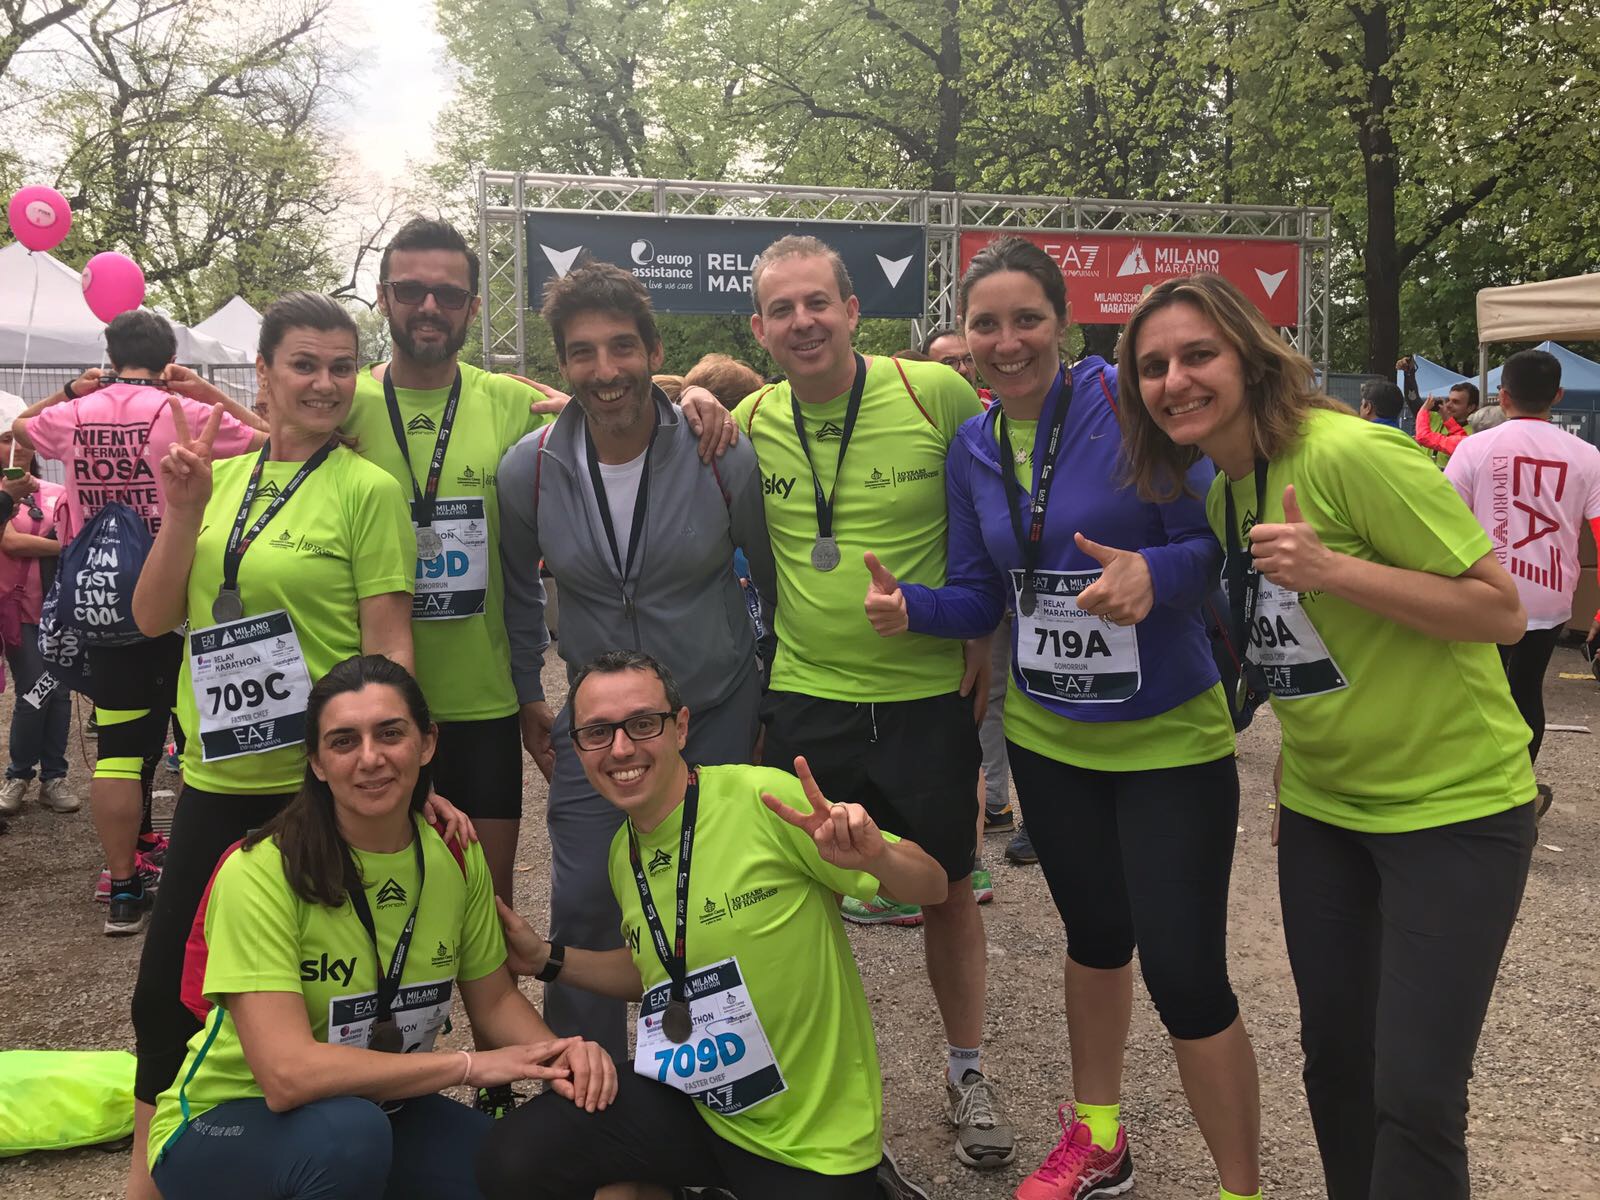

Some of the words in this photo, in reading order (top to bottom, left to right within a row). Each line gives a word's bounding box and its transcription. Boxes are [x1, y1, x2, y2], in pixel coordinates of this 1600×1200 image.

[657, 254, 692, 267] europ
[708, 253, 760, 271] RELA
[1155, 248, 1219, 264] MILANO
[632, 265, 693, 278] assistance
[1155, 263, 1219, 274] MARATHON
[648, 280, 662, 289] live
[677, 281, 693, 290] care
[708, 275, 753, 292] MAR
[1094, 293, 1122, 302] MILANO
[73, 428, 150, 446] NIENTE
[84, 447, 130, 458] FERMA
[74, 458, 154, 480] ROSA
[765, 473, 796, 499] sky
[1493, 456, 1508, 521] EMPORIO
[79, 488, 159, 505] NIENTE
[1511, 456, 1568, 592] EA7
[87, 547, 118, 570] RUN
[416, 551, 470, 578] 19D
[76, 569, 120, 589] FAST
[1069, 578, 1098, 587] MILAN
[74, 588, 120, 605] LIVE
[1044, 600, 1065, 608] RELAY
[74, 607, 125, 626] COOL
[1044, 608, 1091, 618] MARATHON
[234, 621, 269, 635] MILANO
[1251, 614, 1299, 648] 09A
[201, 634, 215, 647] EA7
[1035, 627, 1112, 658] 719A
[214, 653, 234, 663] RELAY
[215, 656, 261, 672] MARATHON
[1052, 674, 1095, 692] EA7
[1263, 667, 1290, 688] EA7
[206, 672, 291, 715] 709C
[231, 713, 252, 724] FASTER
[253, 709, 269, 720] CHEF
[233, 720, 275, 745] EA7
[732, 903, 742, 911] OF
[743, 888, 778, 907] HAPPINESS
[741, 888, 763, 900] YEARS
[300, 952, 357, 987] sky
[691, 973, 719, 988] MILANO
[693, 981, 720, 993] MARATHON
[406, 988, 438, 1000] MILANO
[650, 988, 671, 1006] EA7
[354, 998, 378, 1014] EA7
[692, 1012, 714, 1025] THON
[655, 1032, 746, 1083] 709D
[684, 1077, 709, 1091] FASTER
[709, 1073, 726, 1084] CHEF
